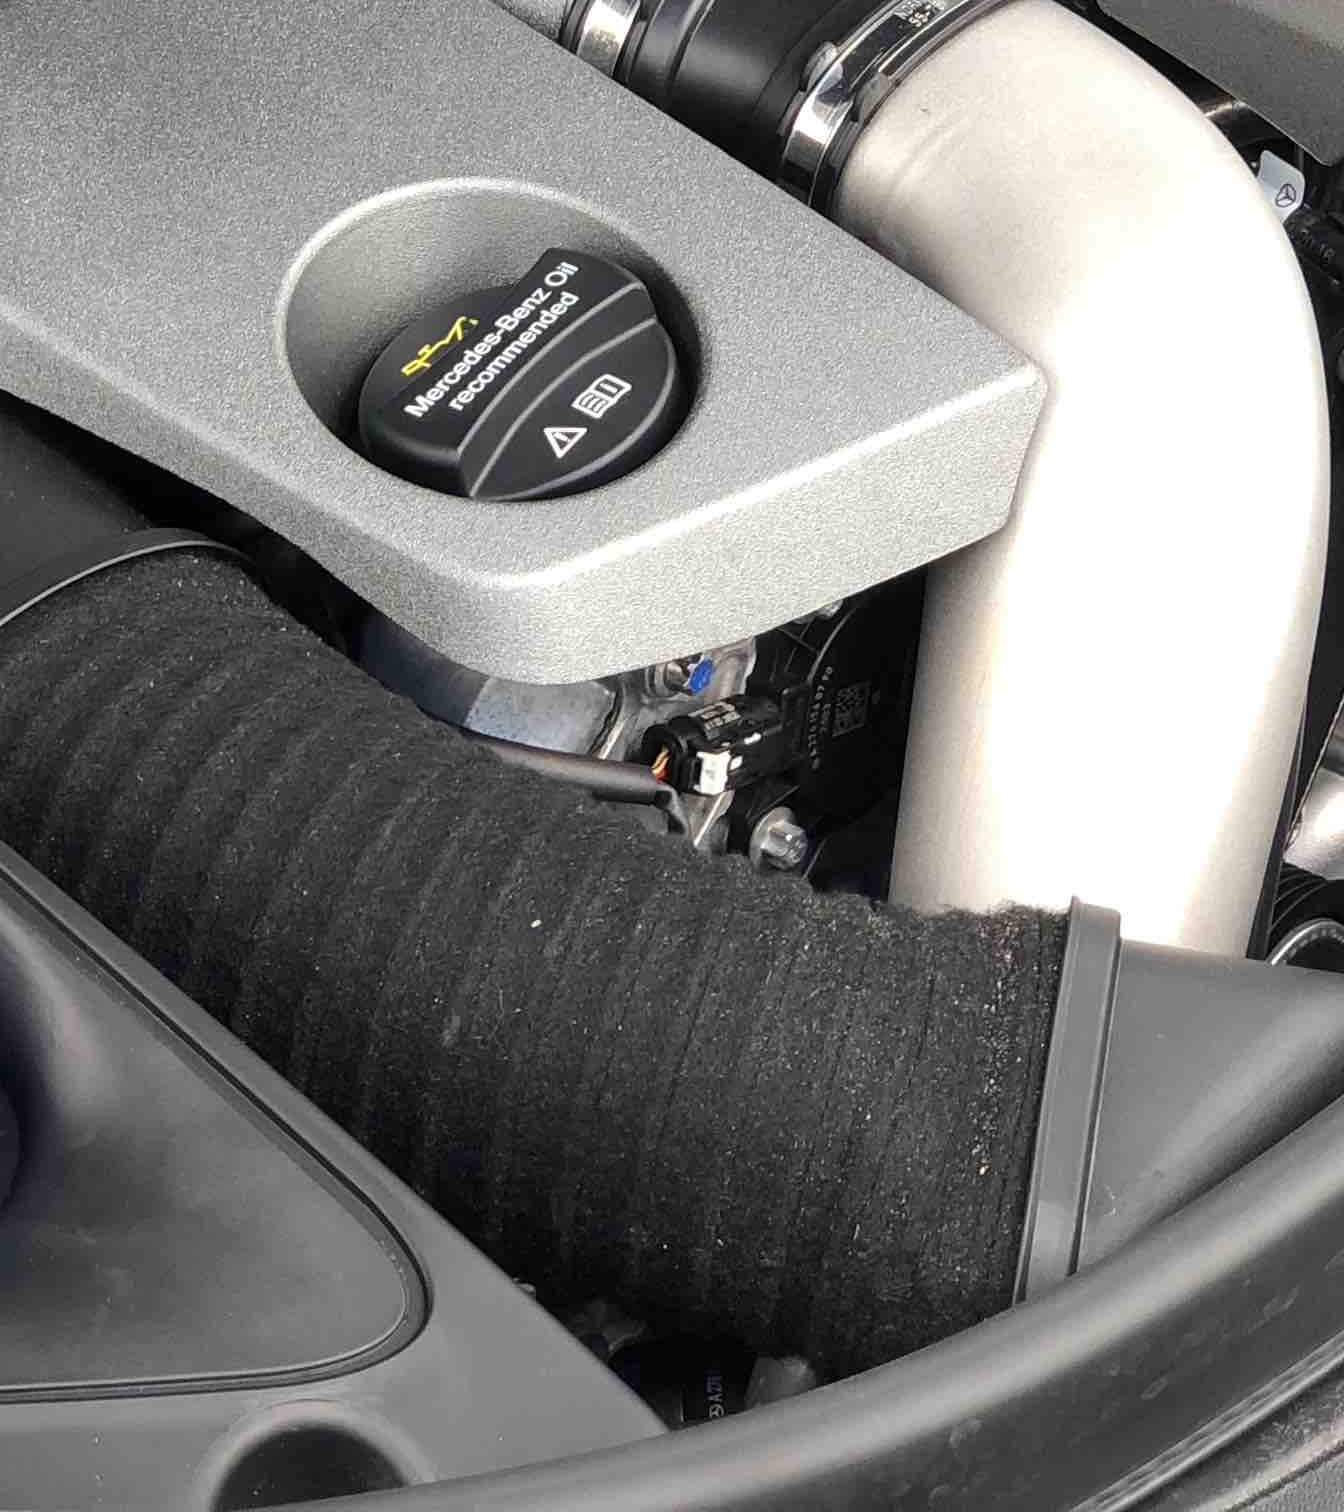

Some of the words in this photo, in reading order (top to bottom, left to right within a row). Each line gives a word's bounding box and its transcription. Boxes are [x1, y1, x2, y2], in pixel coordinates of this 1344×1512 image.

[404, 288, 553, 418] Mercedes-Benz
[545, 262, 579, 287] Oil
[448, 292, 580, 412] recommended
